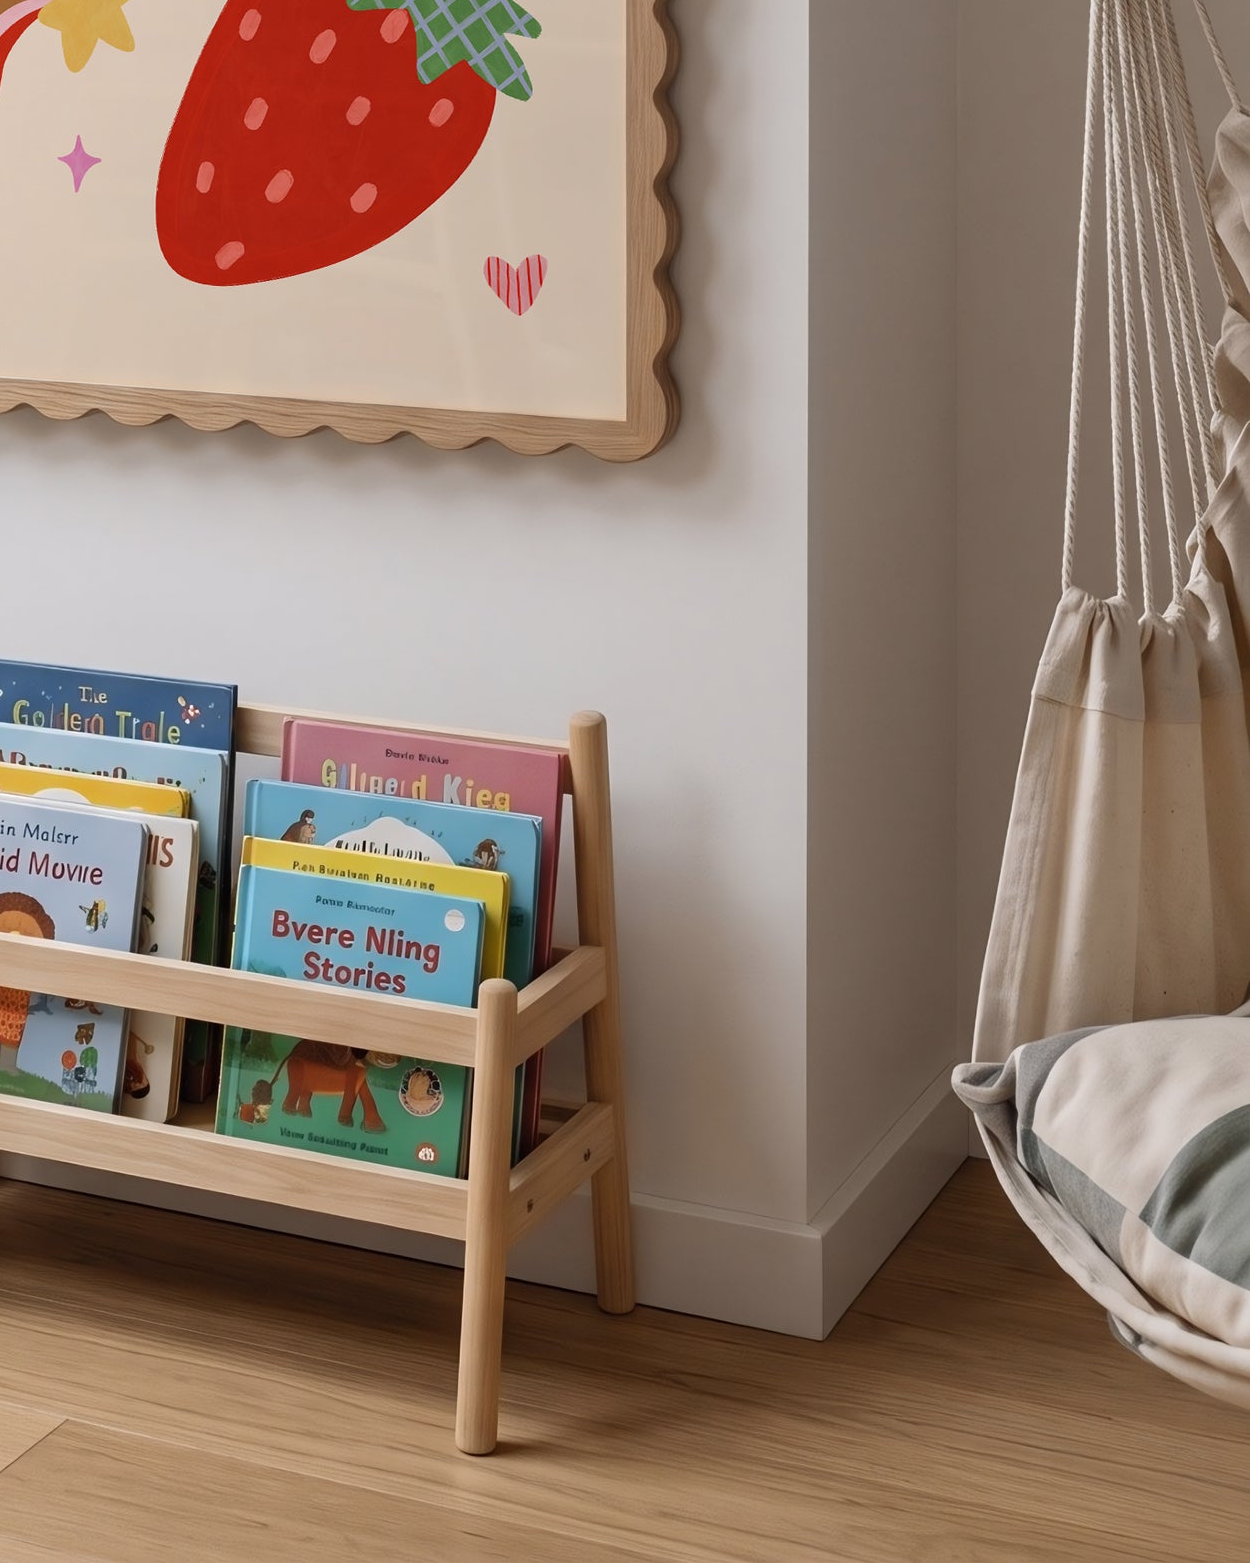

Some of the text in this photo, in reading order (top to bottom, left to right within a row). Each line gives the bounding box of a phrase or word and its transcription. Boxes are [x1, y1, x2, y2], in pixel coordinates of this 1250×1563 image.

[78, 686, 108, 704] The
[272, 909, 441, 973] Bvere Nling
[303, 951, 407, 994] Stories
